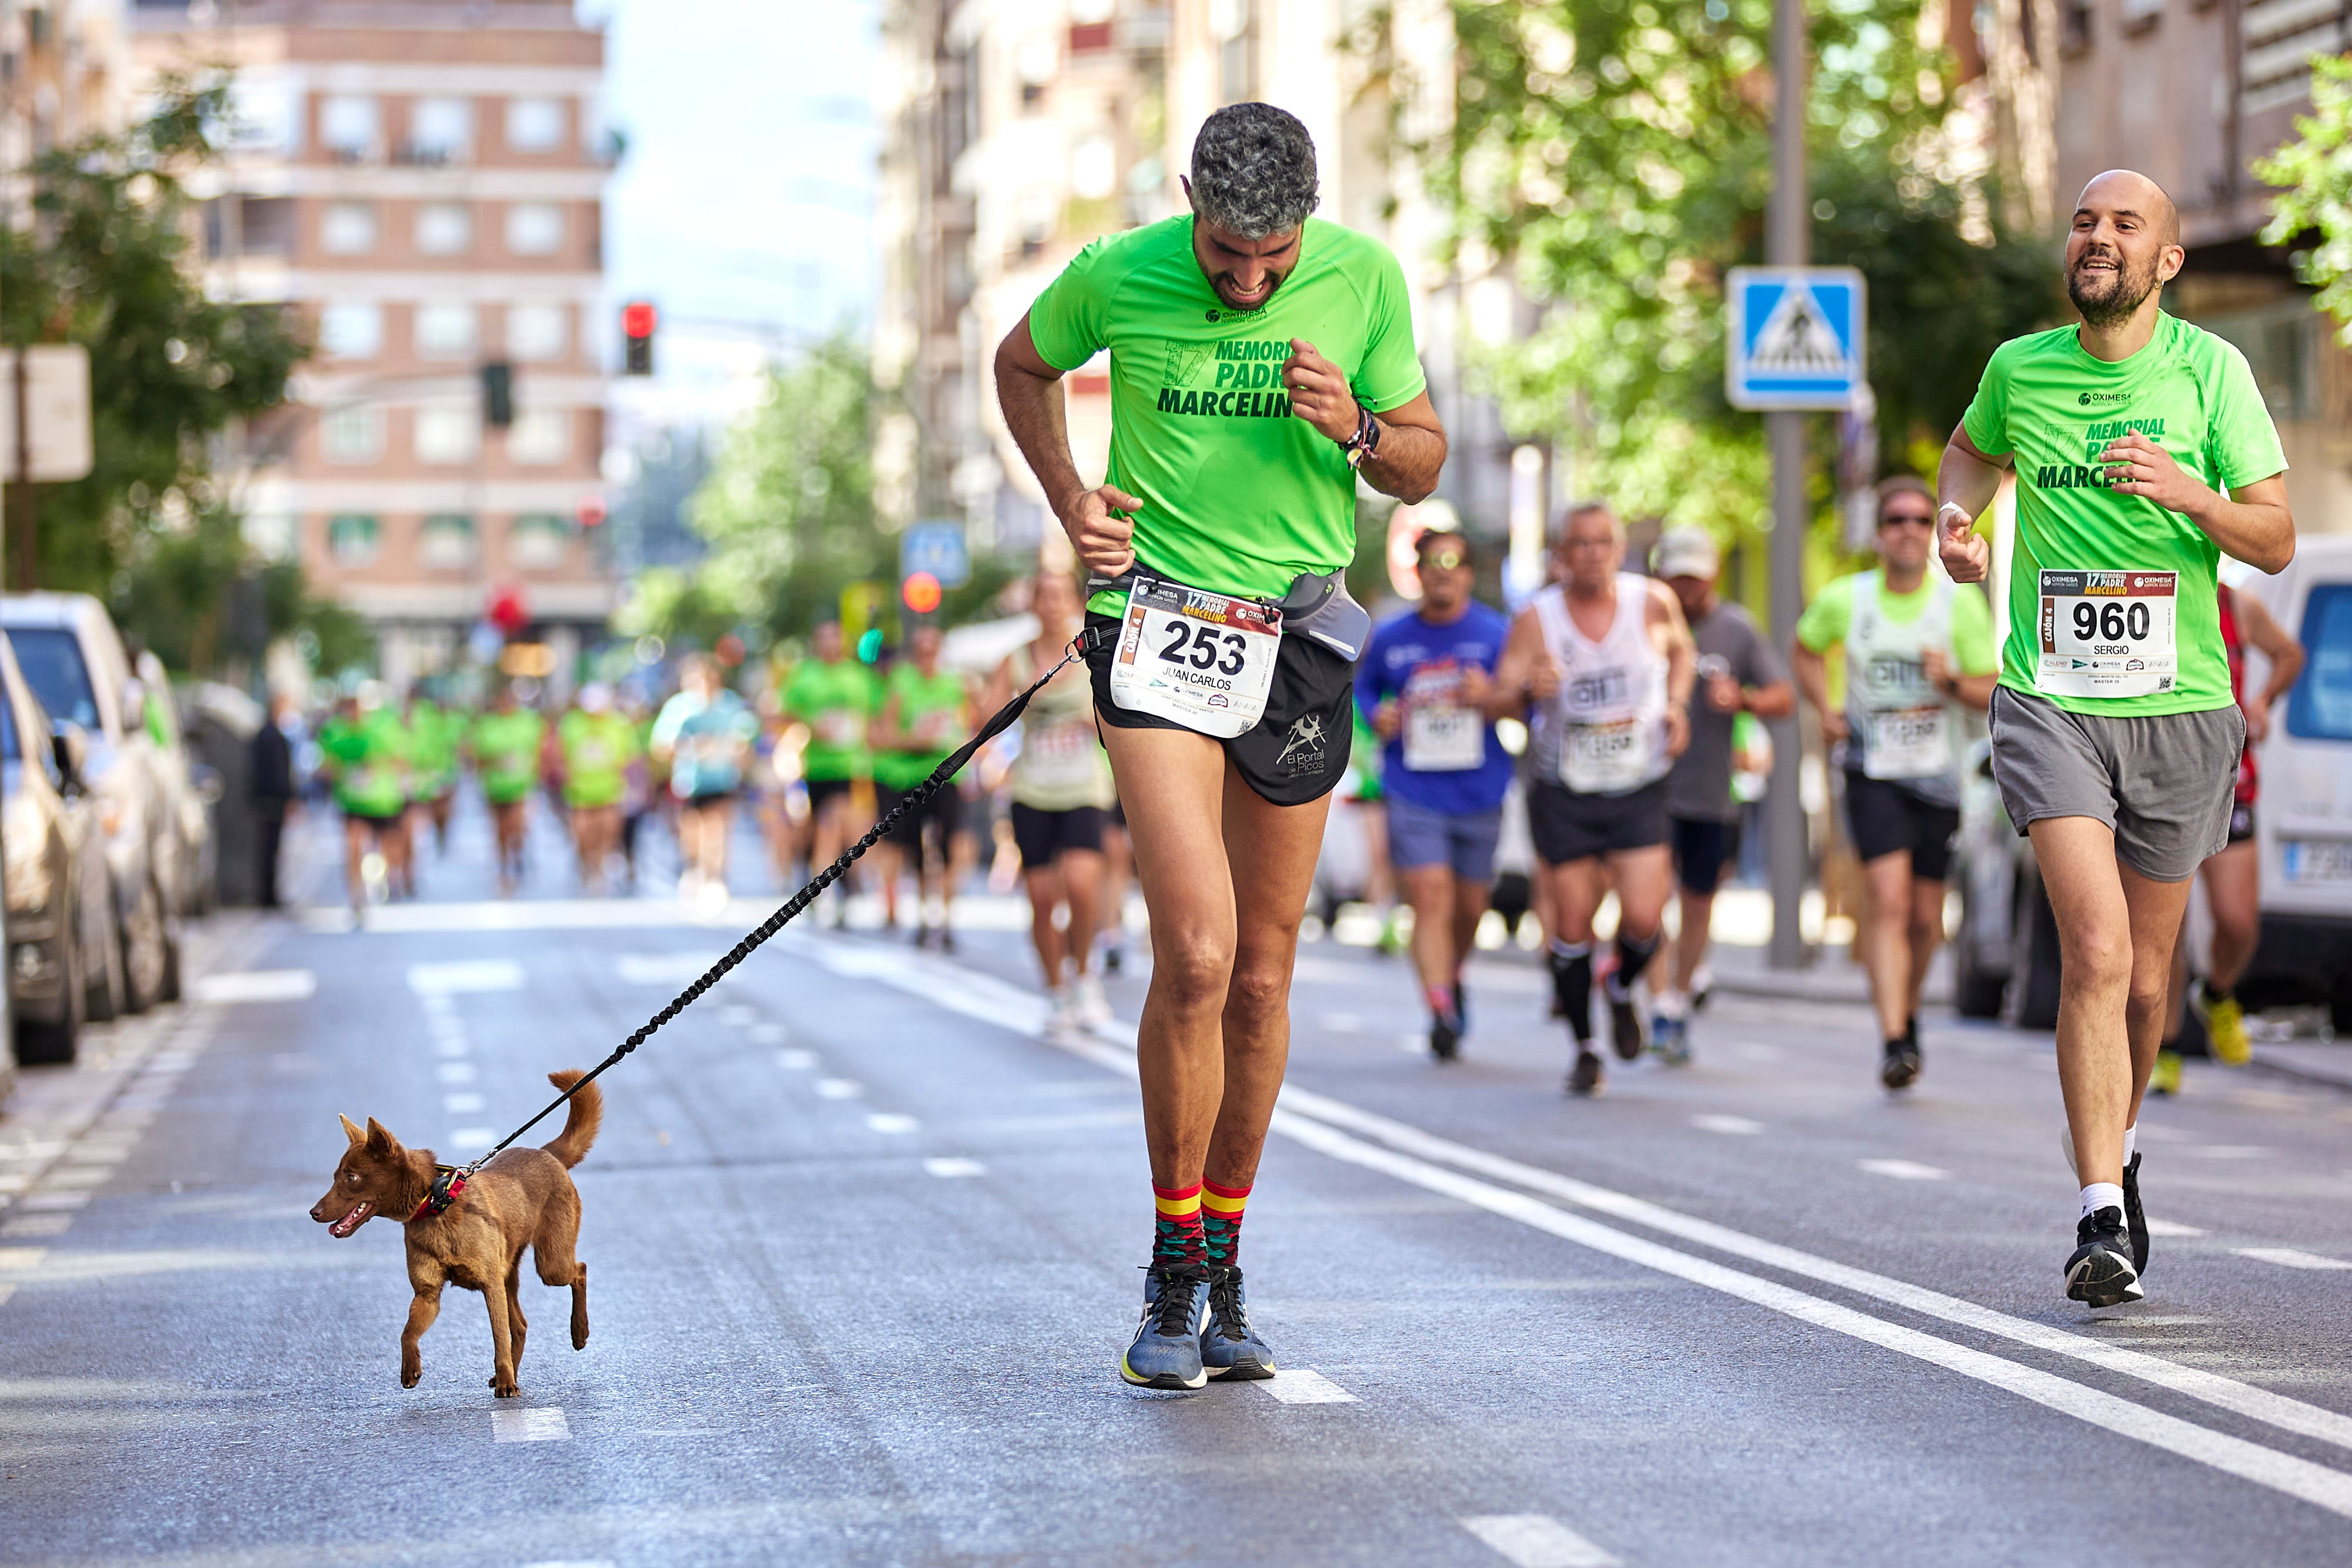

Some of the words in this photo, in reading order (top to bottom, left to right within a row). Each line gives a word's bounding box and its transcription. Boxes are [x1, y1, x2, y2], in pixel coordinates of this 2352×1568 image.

[1215, 340, 1295, 361] MEMORI
[1164, 339, 1217, 387] 17
[1215, 362, 1287, 389] PADR
[1157, 387, 1294, 417] MARCELIN
[2093, 393, 2131, 401] OXIMESA
[2085, 418, 2165, 440] MEMORIAL
[2086, 573, 2101, 587] 17
[2100, 579, 2125, 587] PADRE
[1156, 589, 1178, 599] IMESA
[2084, 586, 2127, 595] MARCELINO
[1186, 591, 1202, 607] 17
[1201, 595, 1230, 607] MEMORIAL
[1181, 605, 1227, 623] MARCELINO
[1200, 601, 1227, 614] PADRE
[1247, 611, 1265, 619] OXIM
[2073, 602, 2150, 640] 960
[2043, 616, 2053, 642] CAJÓN
[1158, 620, 1246, 676] 253
[2094, 645, 2129, 654] SERGIO
[1163, 666, 1189, 681] JUAN
[1191, 673, 1231, 690] CARLOS
[1172, 703, 1191, 713] MASTER
[1287, 754, 1295, 764] El
[1297, 749, 1324, 763] Portal
[1298, 761, 1324, 771] Picos
